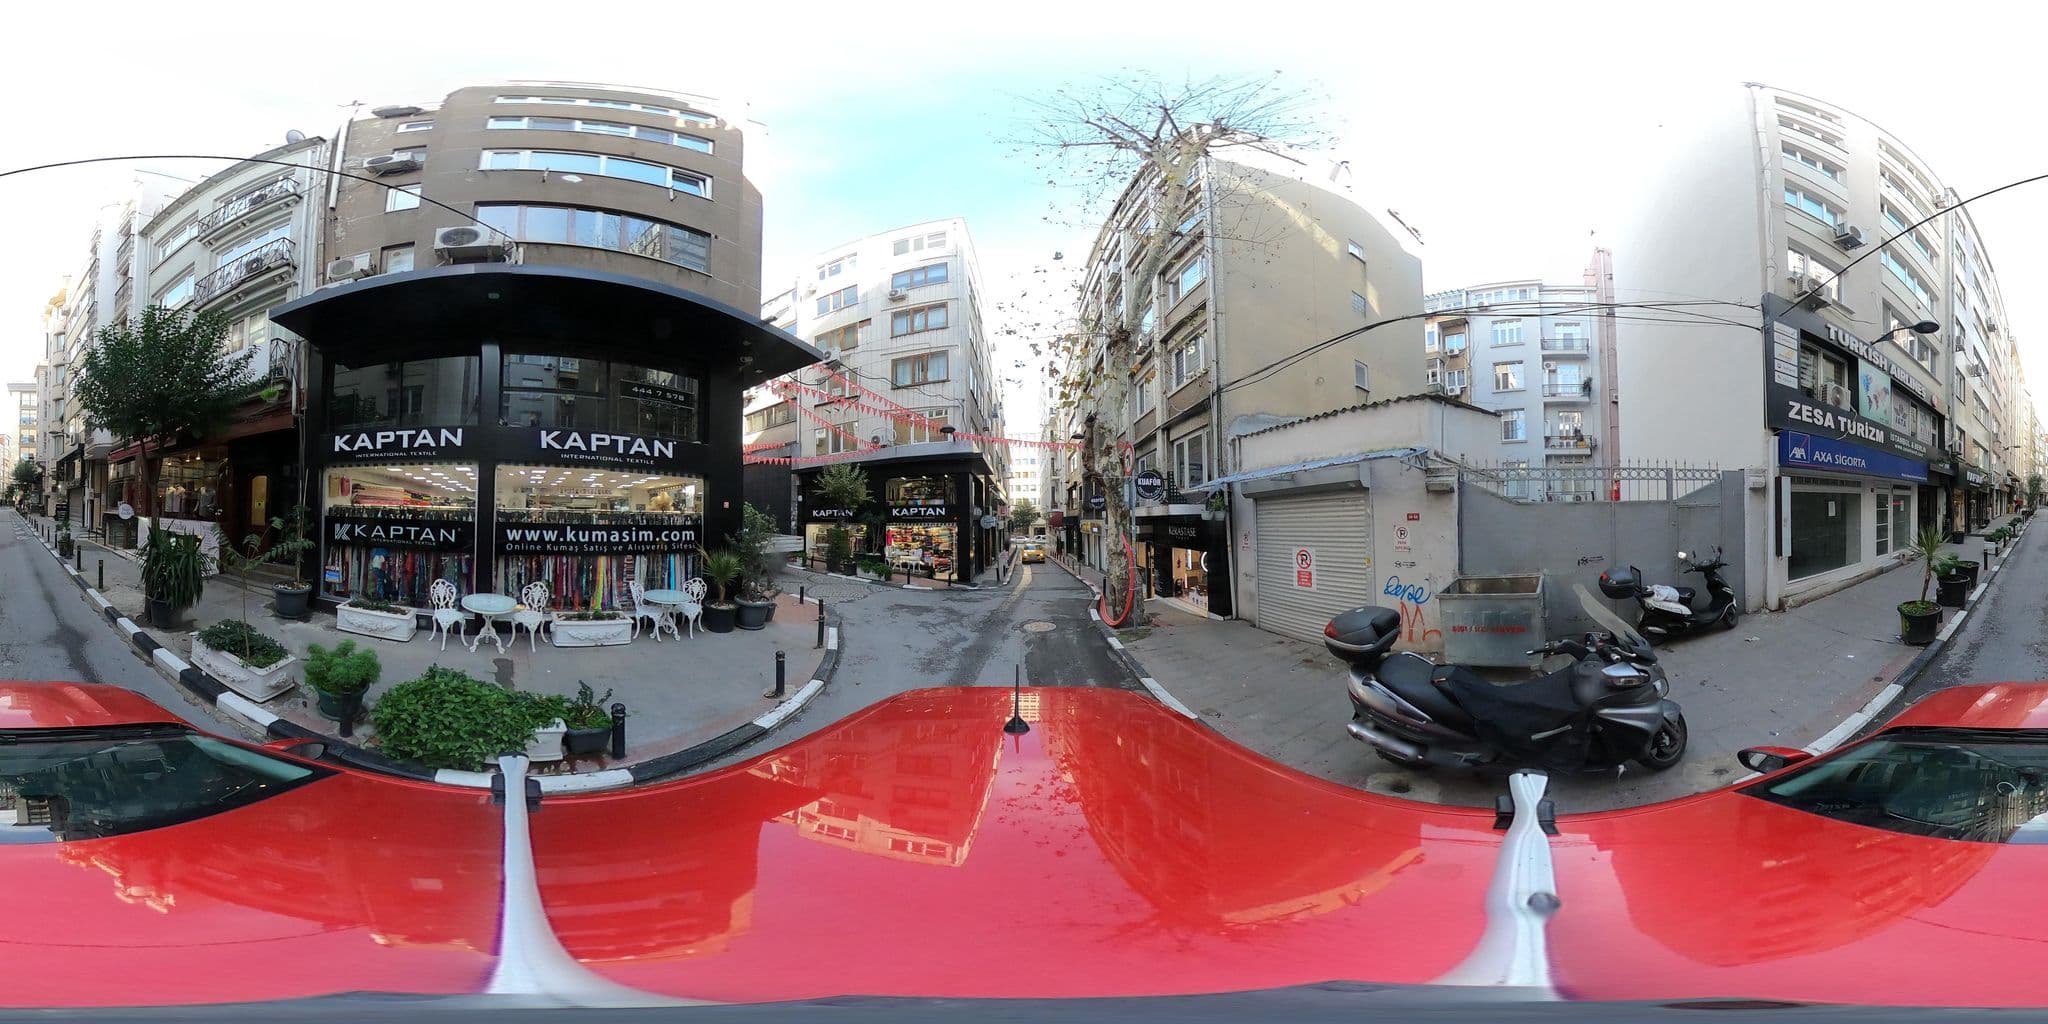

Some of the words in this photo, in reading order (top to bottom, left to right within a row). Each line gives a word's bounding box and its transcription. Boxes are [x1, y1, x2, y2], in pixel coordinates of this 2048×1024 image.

[1826, 323, 1888, 371] TURKISH
[1890, 363, 1927, 399] AIRLINES
[632, 386, 652, 395] 444
[1788, 401, 1835, 429] ZESA
[1838, 415, 1884, 444] TURİZM
[334, 428, 463, 451] KAPTAN
[540, 430, 674, 459] KAPTAN
[561, 453, 624, 462] INTERNATIONAL
[626, 457, 654, 465] TEXTILE
[1789, 446, 1806, 460] AXA
[1813, 450, 1833, 463] AXA
[1835, 452, 1866, 468] SİGORTA
[812, 509, 853, 517] KAPTAN
[892, 507, 946, 516] KAPTAN
[355, 524, 456, 543] KAPTAN
[506, 526, 695, 543] www.kumasim.com
[506, 543, 541, 551] Online
[546, 543, 578, 552] Kumaş
[583, 543, 608, 552] Satış
